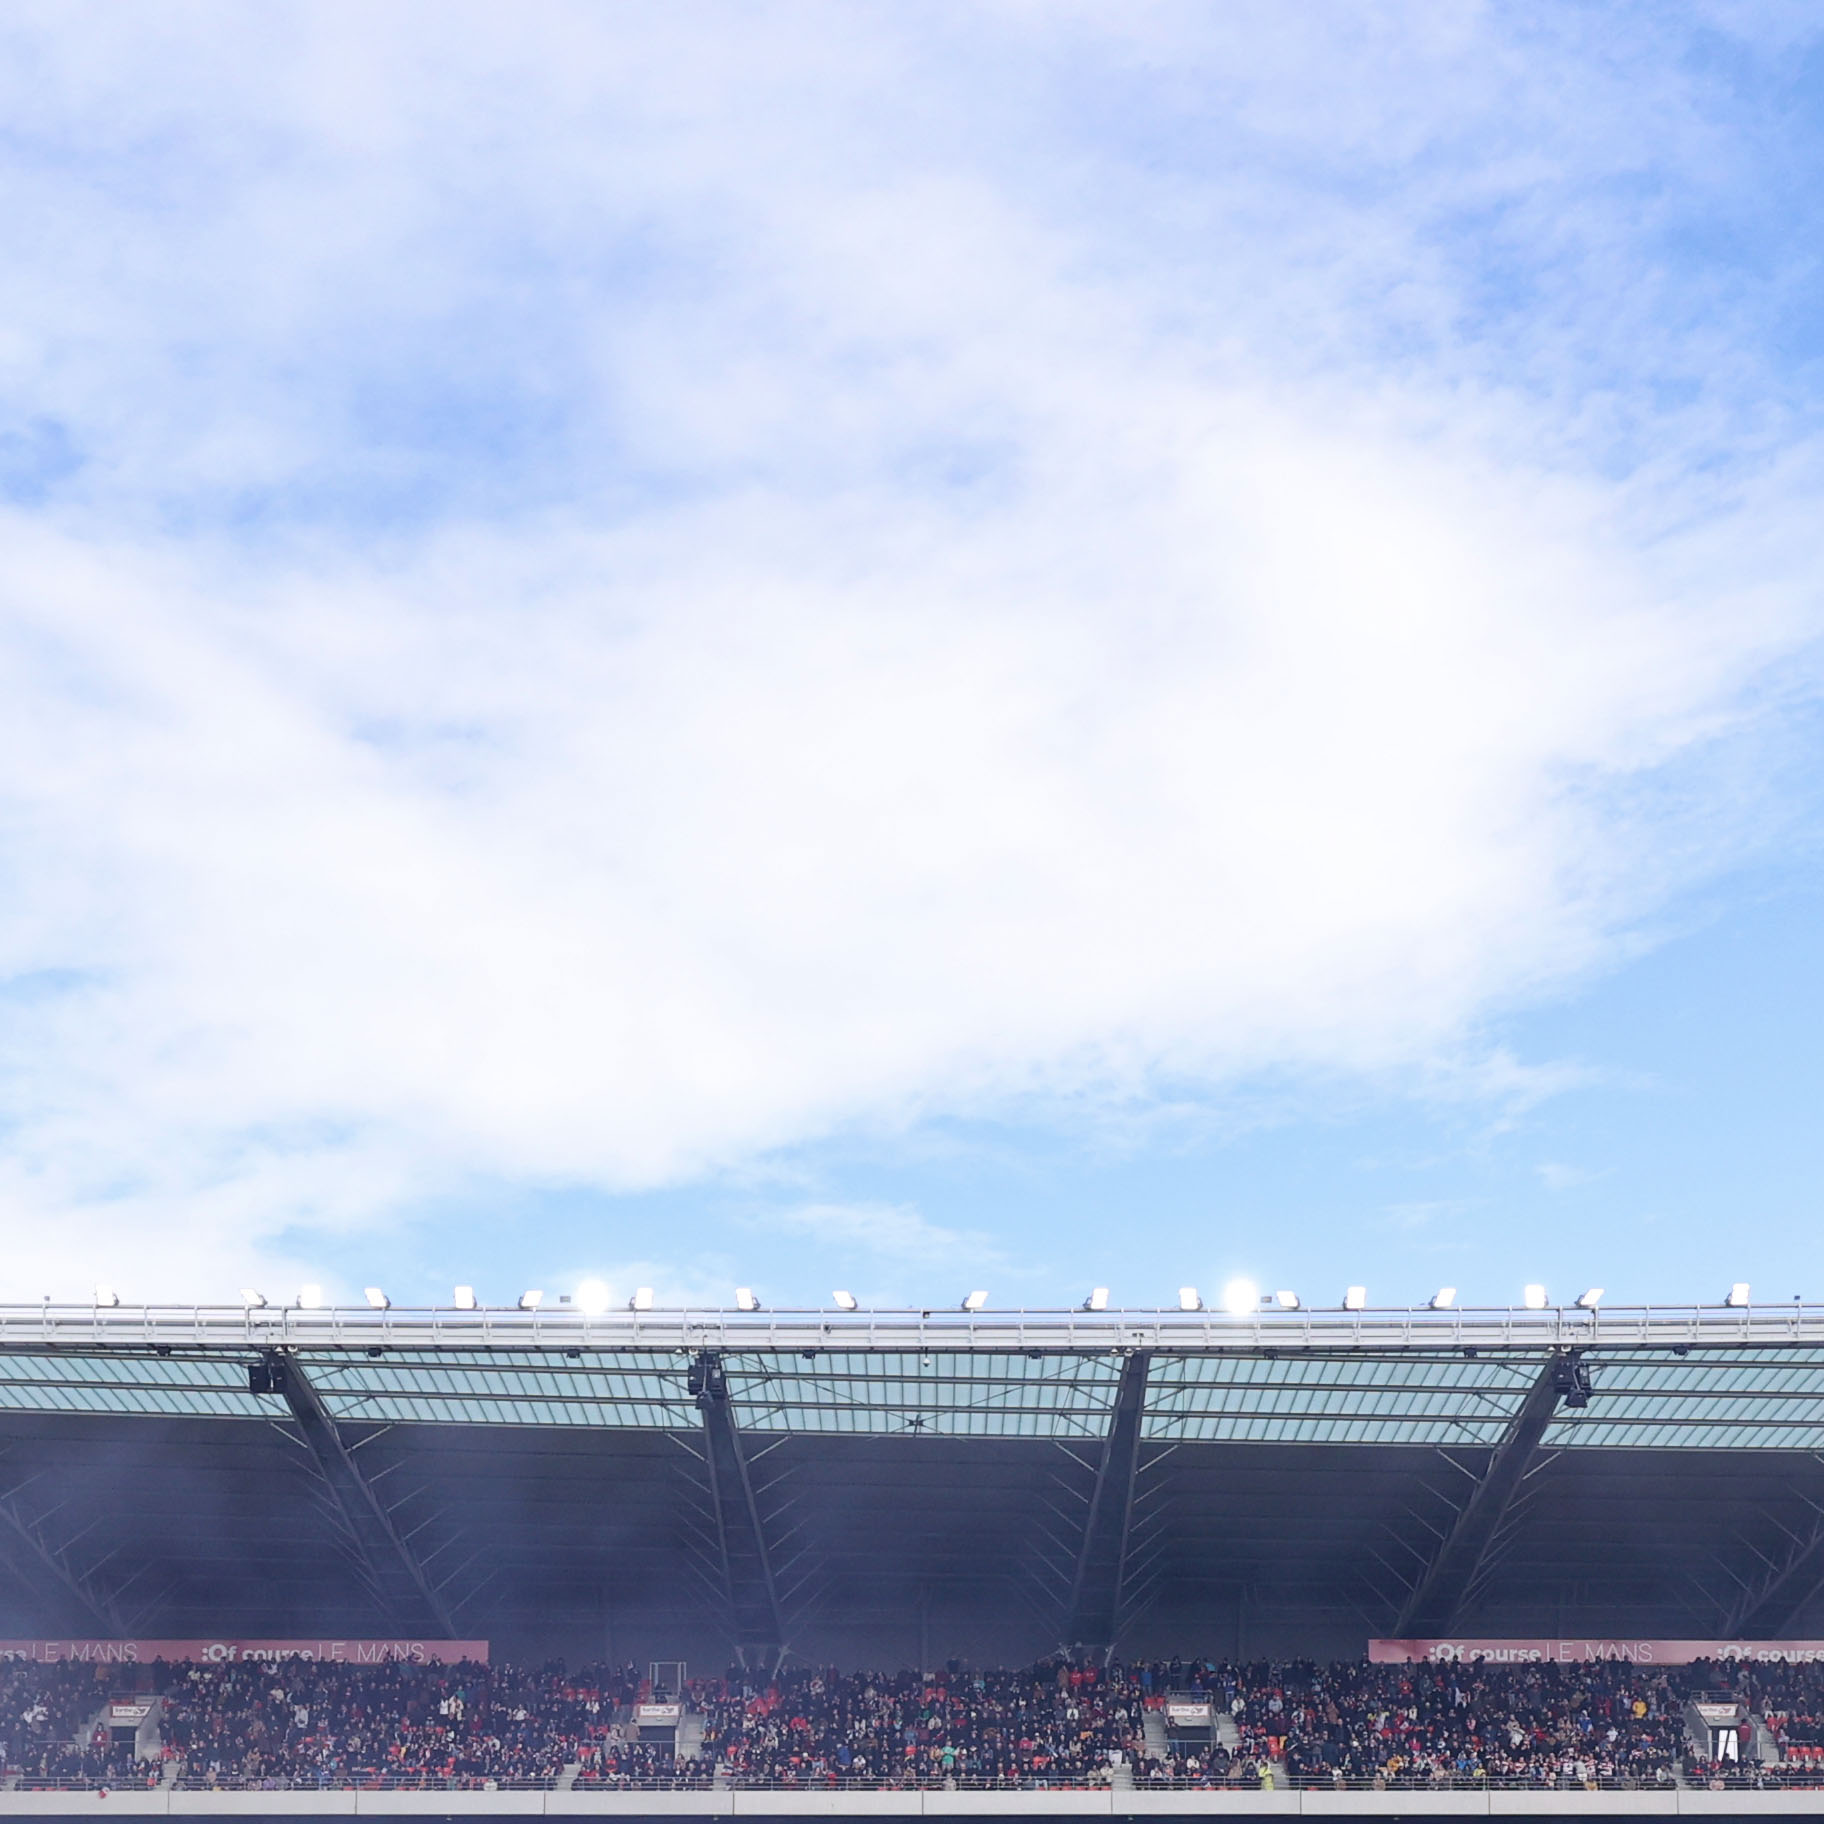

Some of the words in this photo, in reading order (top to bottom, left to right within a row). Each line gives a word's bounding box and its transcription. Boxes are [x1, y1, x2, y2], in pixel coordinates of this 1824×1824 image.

[33, 1643, 60, 1662] LE
[318, 1643, 345, 1661] LE
[357, 1643, 425, 1661] MANS
[1469, 1648, 1541, 1662] course
[1546, 1642, 1574, 1662] LE
[1586, 1642, 1653, 1662] MANS
